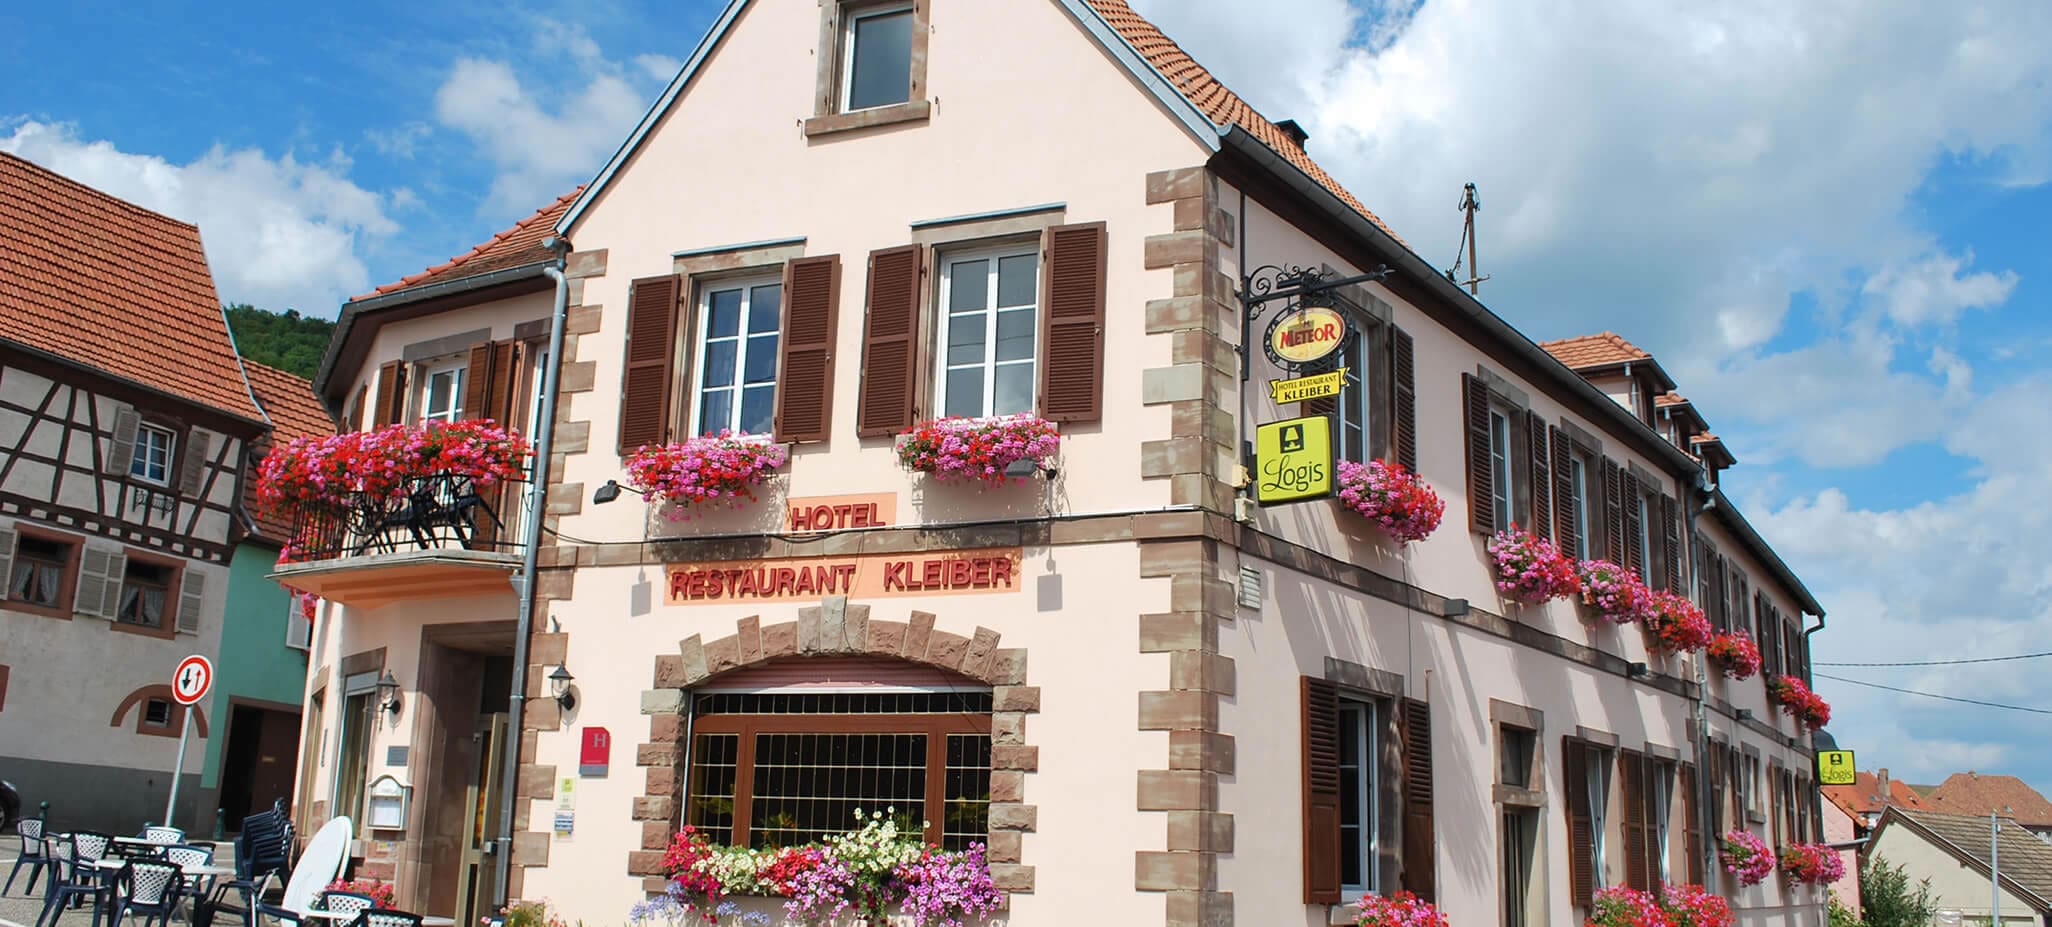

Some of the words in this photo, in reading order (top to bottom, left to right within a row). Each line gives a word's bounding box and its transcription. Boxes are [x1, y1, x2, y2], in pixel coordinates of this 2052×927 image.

[1280, 323, 1336, 349] METEOR
[1279, 380, 1297, 391] HOTEL
[1299, 374, 1337, 388] RESTAURANT
[1284, 384, 1331, 400] KLEIBER
[1261, 455, 1324, 492] Logis
[791, 502, 886, 531] HOTEL
[670, 564, 857, 600] RESTAURANT
[883, 557, 1012, 592] KLEIBER
[593, 733, 607, 748] H
[1822, 767, 1853, 782] Logis
